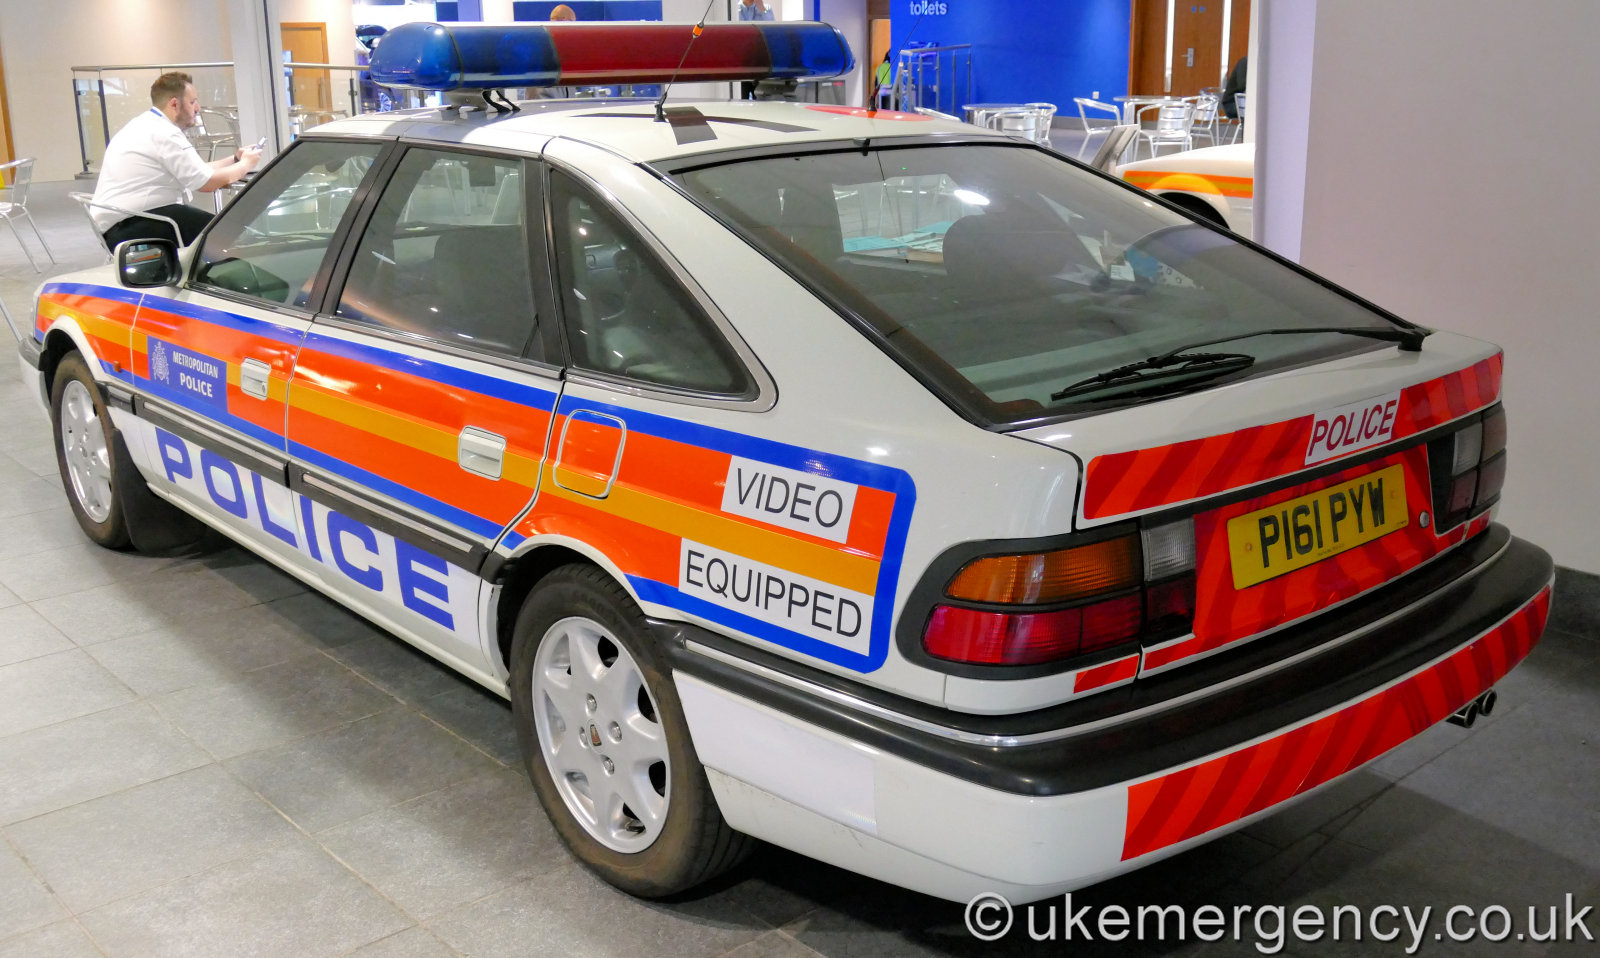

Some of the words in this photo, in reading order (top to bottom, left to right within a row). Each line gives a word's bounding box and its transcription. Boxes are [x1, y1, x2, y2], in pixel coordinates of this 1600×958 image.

[910, 0, 948, 16] toilets
[172, 351, 219, 379] METROPOLITAN
[180, 372, 213, 398] POLICE
[1308, 399, 1397, 457] POLICE
[737, 467, 844, 528] VIDEO
[1258, 500, 1324, 568] P161
[1328, 478, 1386, 543] PYW
[155, 426, 455, 632] POLICE
[686, 549, 862, 638] EQUIPPED
